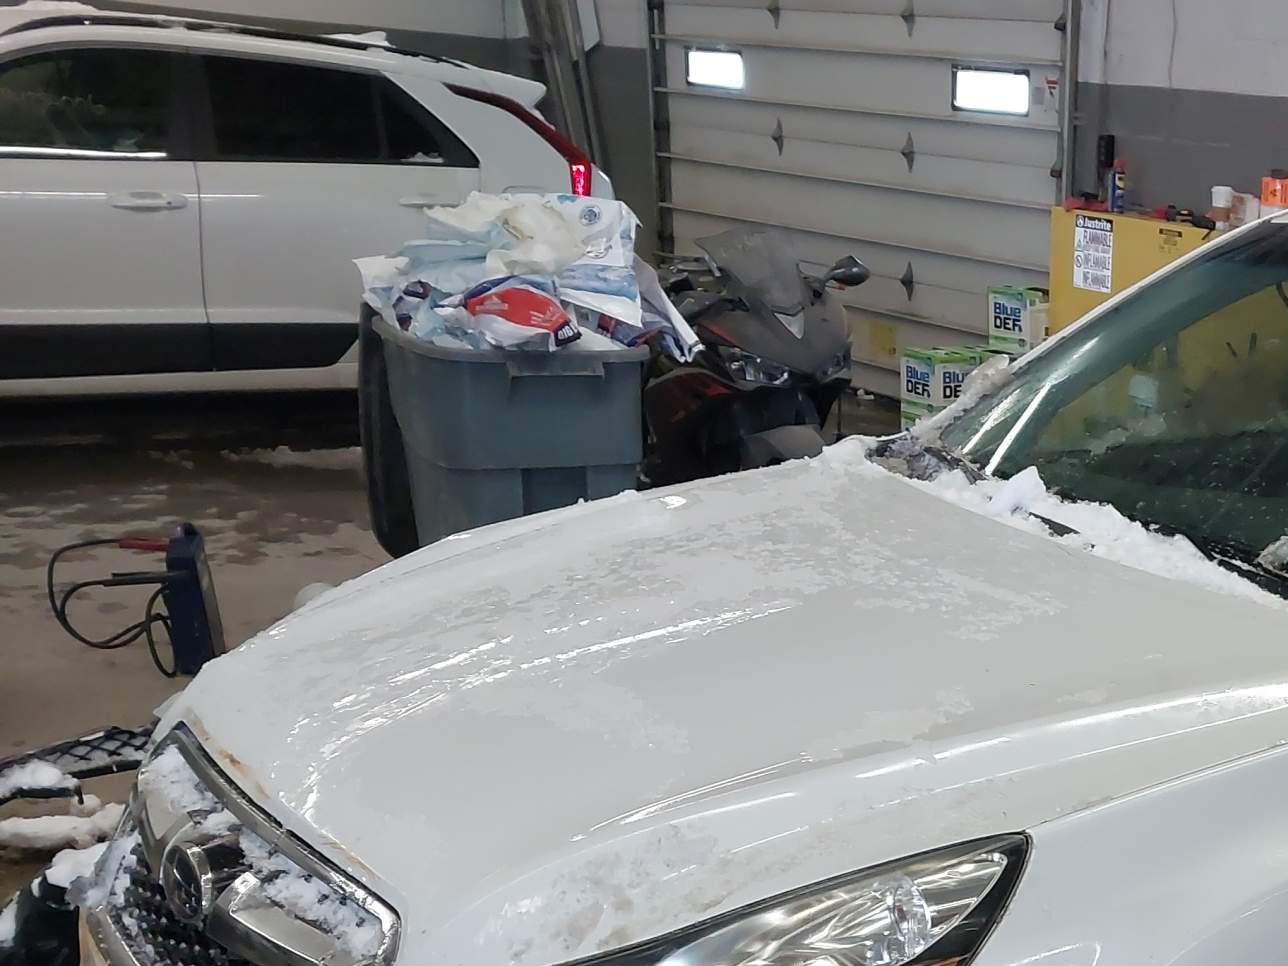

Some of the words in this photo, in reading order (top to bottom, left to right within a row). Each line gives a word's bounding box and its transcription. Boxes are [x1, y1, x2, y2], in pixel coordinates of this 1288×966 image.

[1084, 217, 1112, 231] Justrite
[994, 301, 1021, 318] Blue
[905, 365, 930, 383] Blue
[942, 371, 965, 384] Blu
[942, 384, 962, 399] DE
